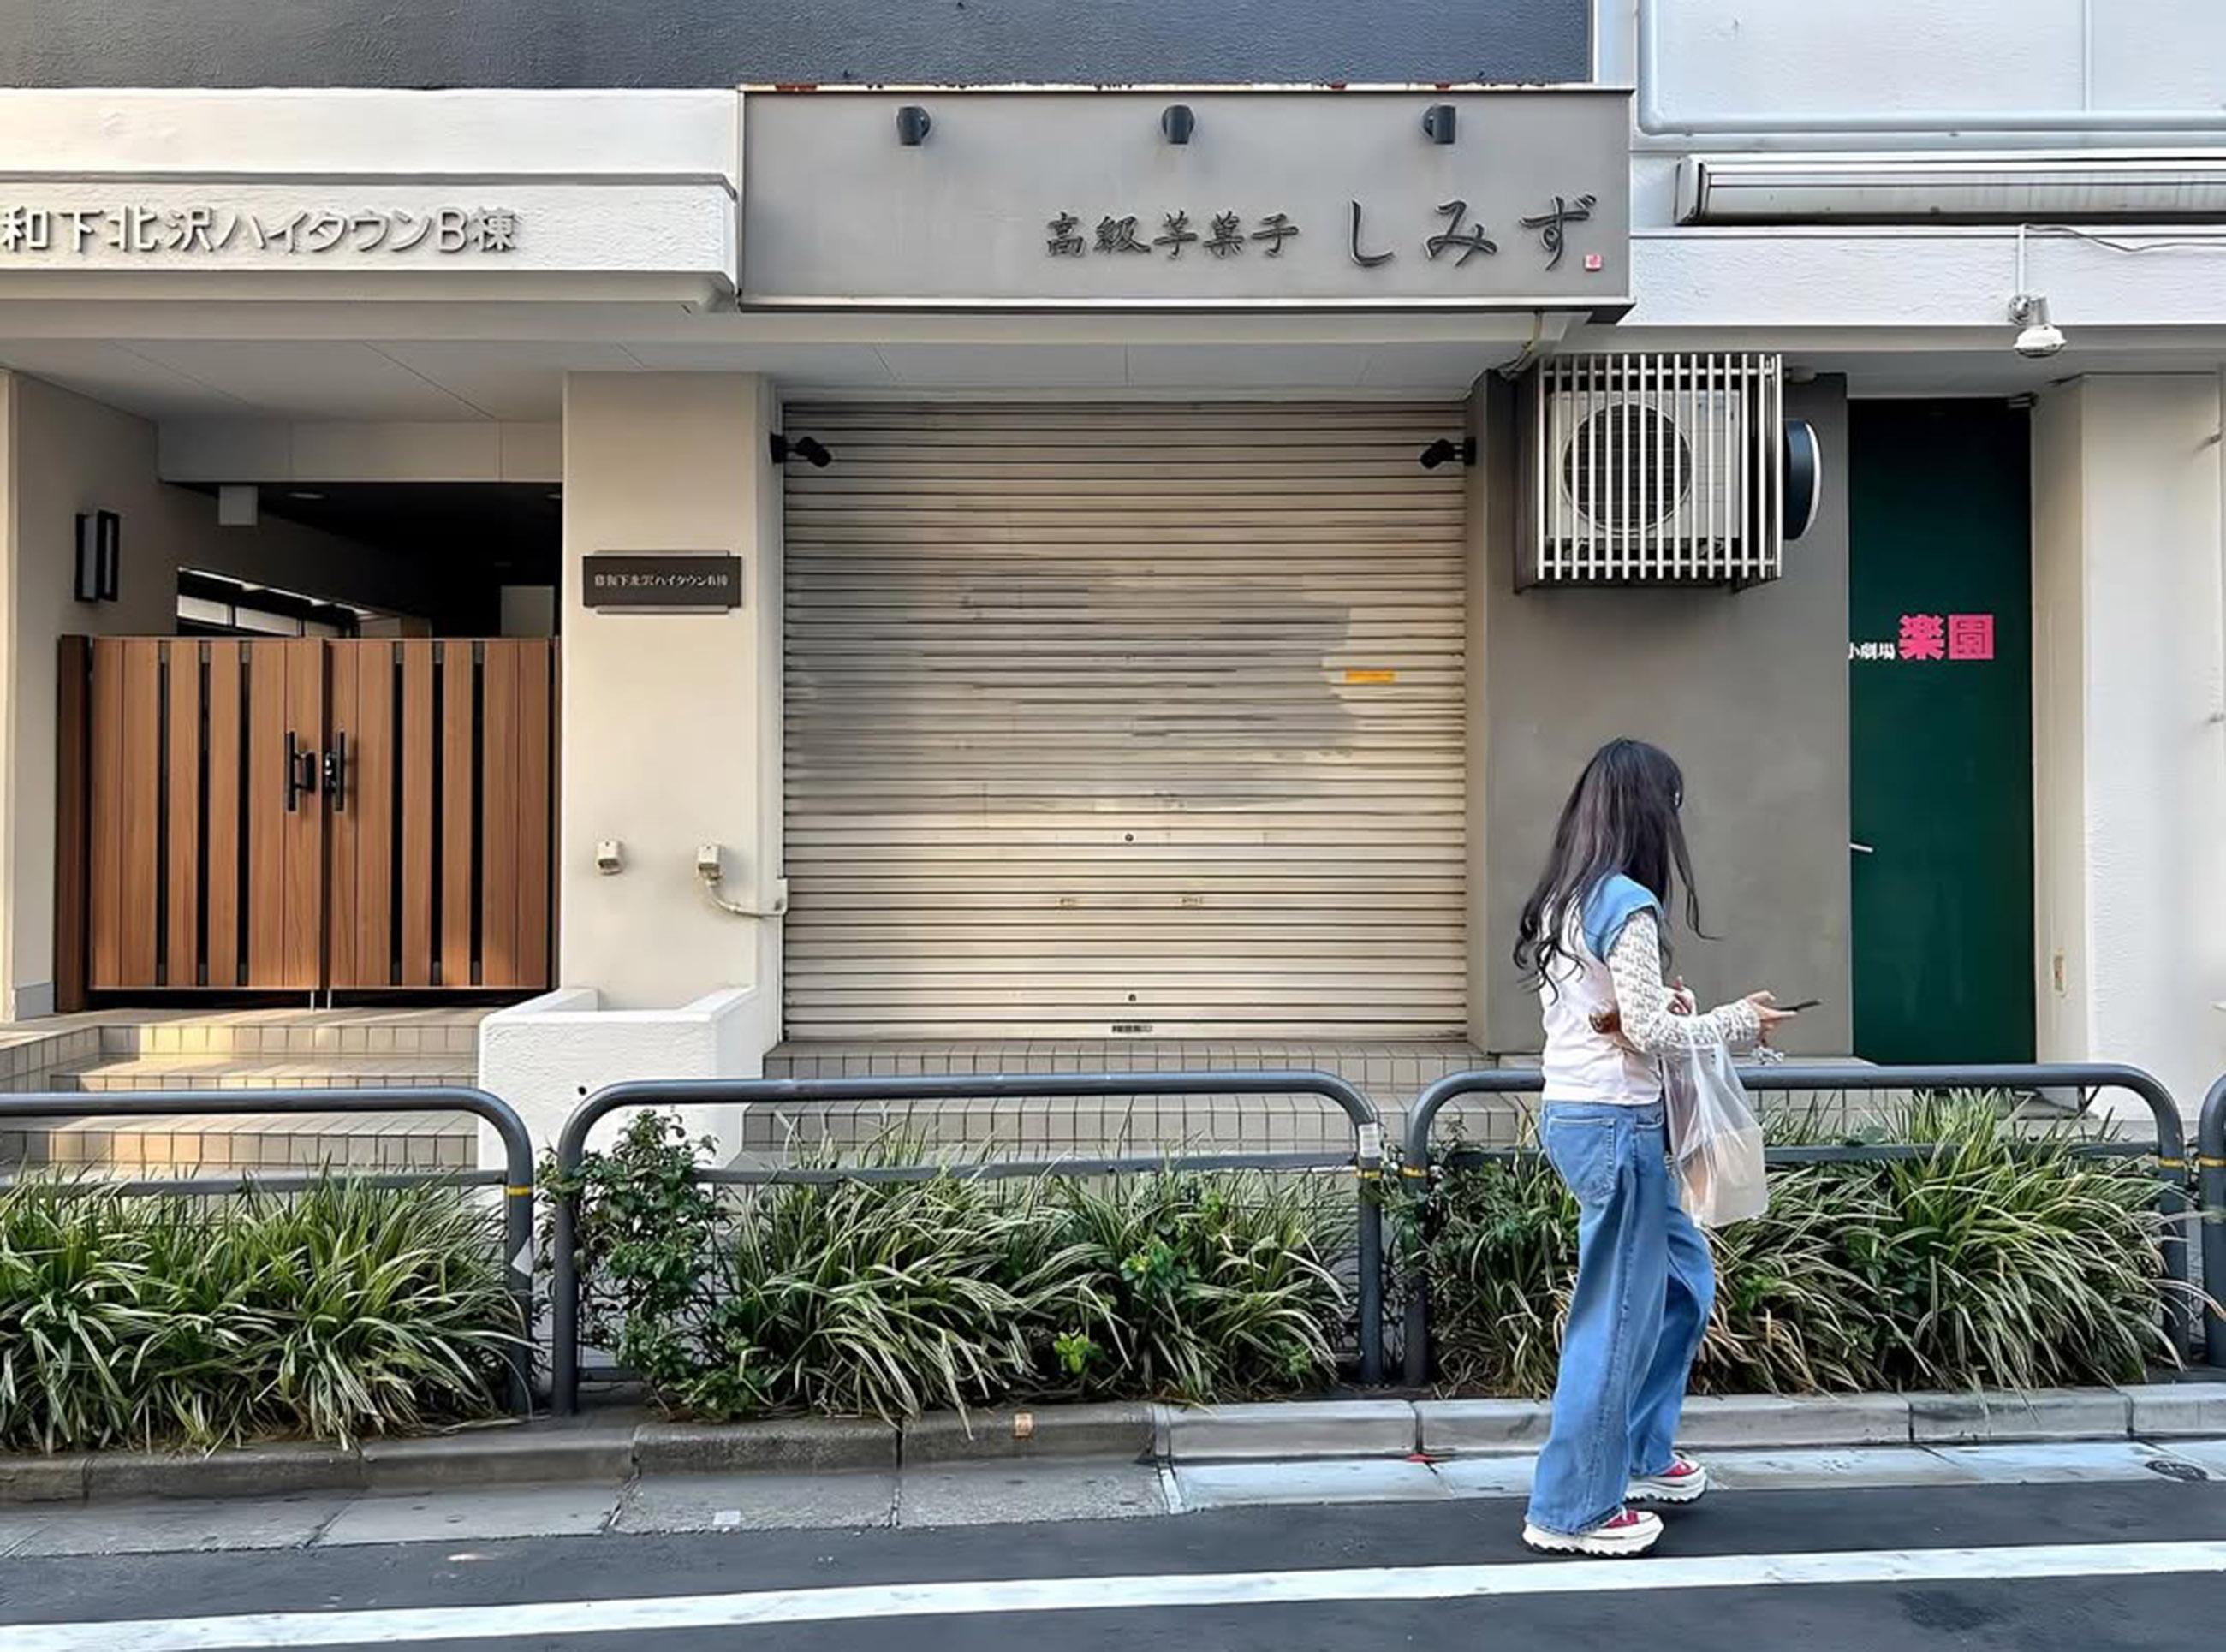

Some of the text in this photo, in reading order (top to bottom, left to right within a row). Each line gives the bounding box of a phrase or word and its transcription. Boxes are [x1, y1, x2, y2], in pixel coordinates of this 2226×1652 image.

[0, 205, 519, 254] 和下北沢ハイタウンB棟
[1046, 193, 1597, 272] 高級芋菓子 しみず
[1899, 614, 1994, 660] 楽園
